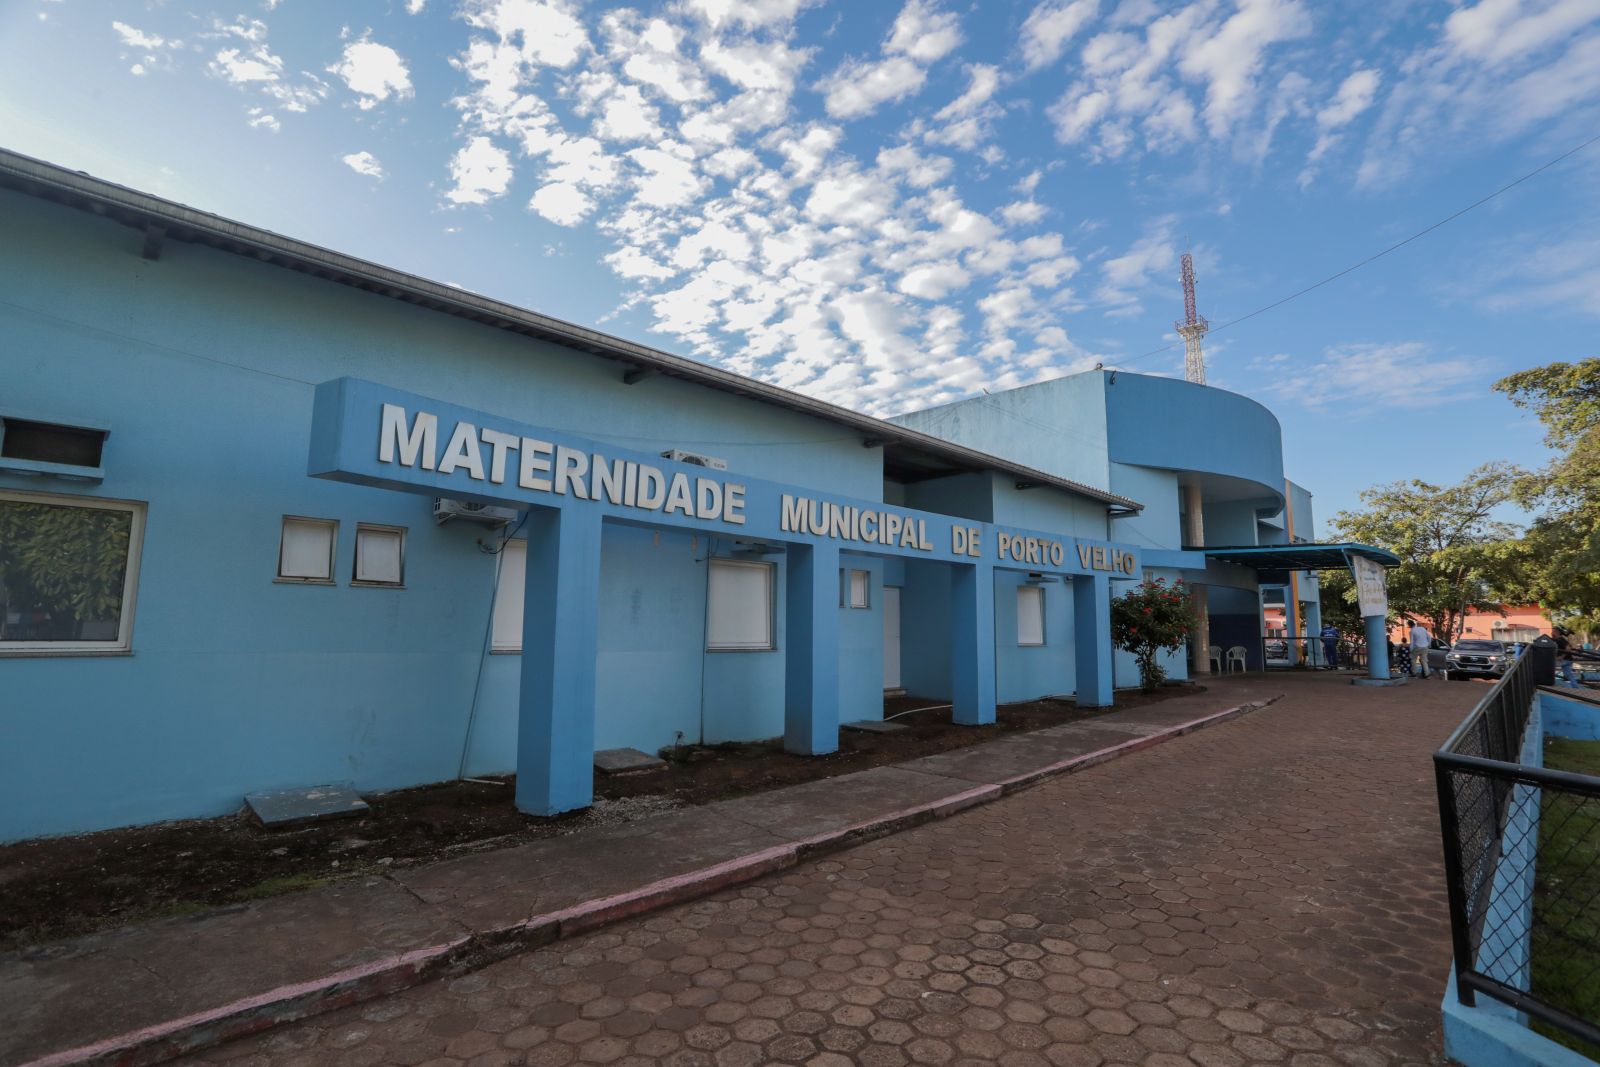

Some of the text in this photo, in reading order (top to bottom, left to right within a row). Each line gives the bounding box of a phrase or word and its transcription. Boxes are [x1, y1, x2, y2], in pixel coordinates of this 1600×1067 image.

[379, 403, 1137, 576] MATERNIDADE MUNICIPAL DE PORTO VELHO
